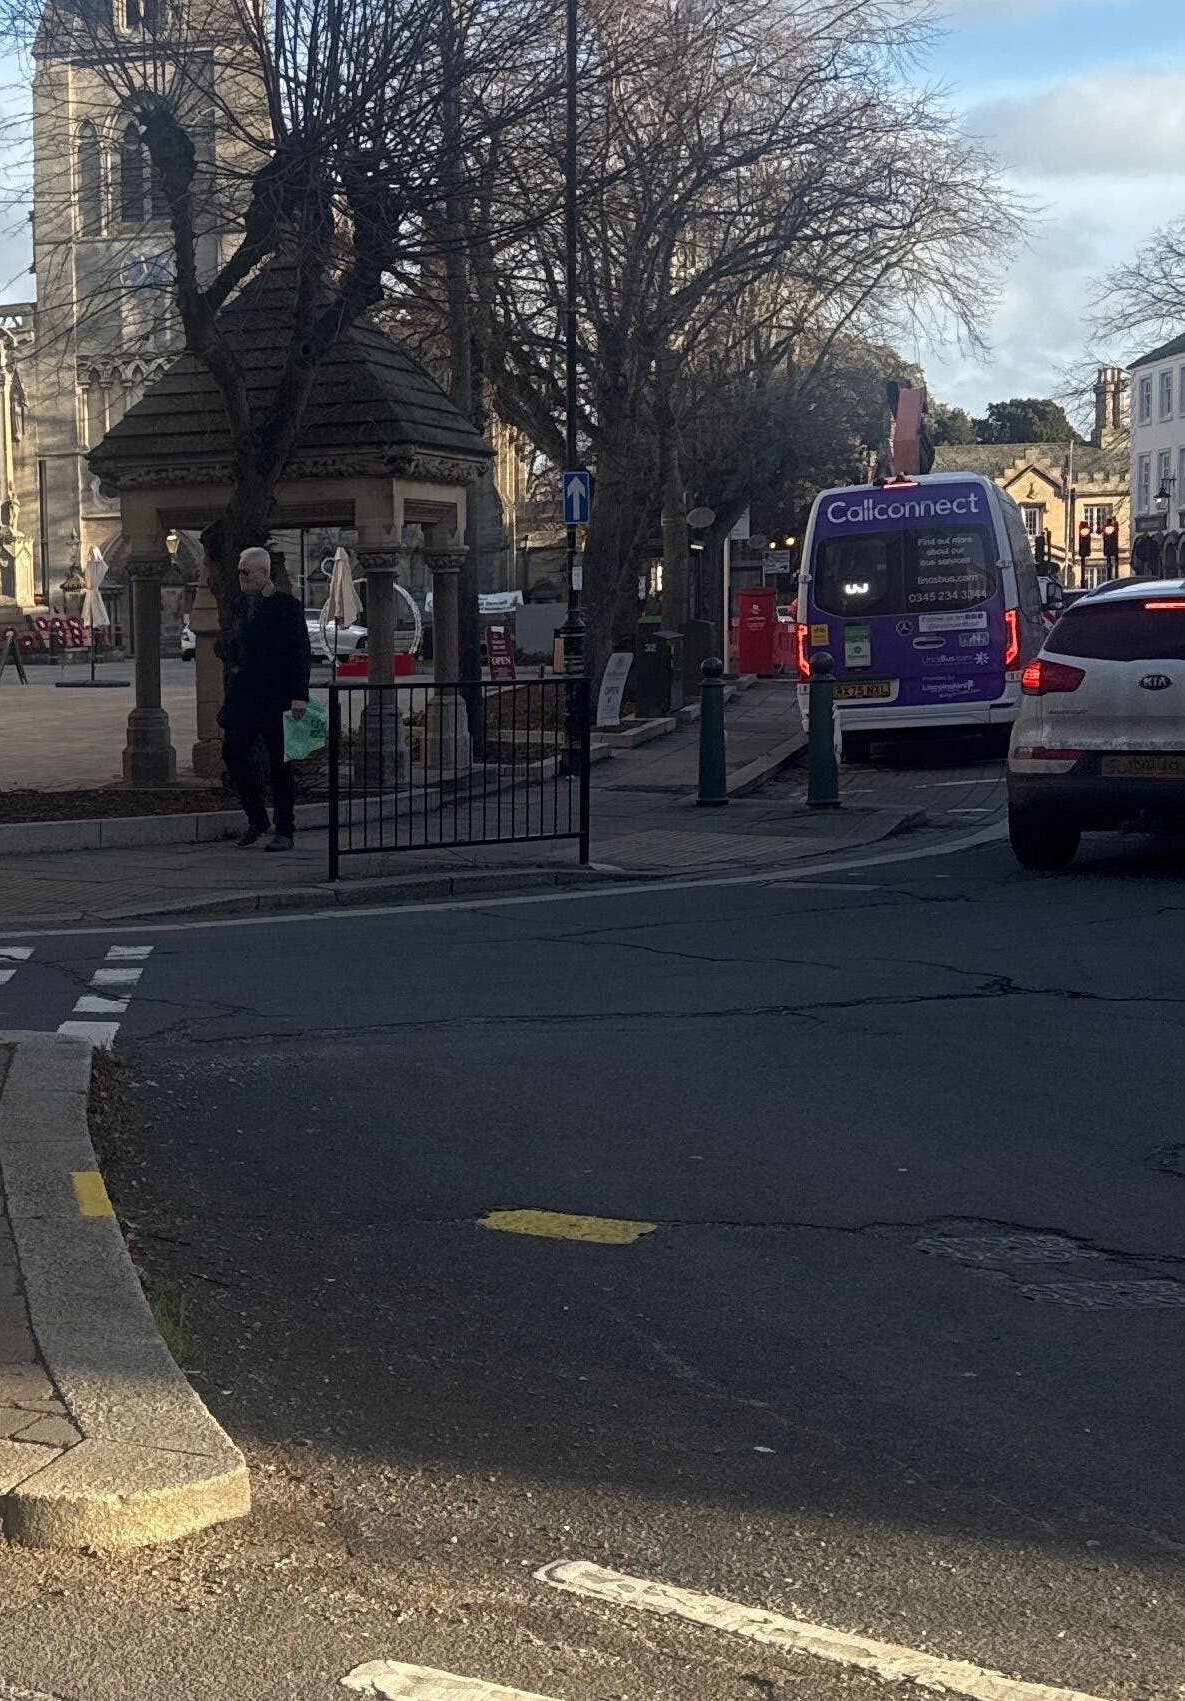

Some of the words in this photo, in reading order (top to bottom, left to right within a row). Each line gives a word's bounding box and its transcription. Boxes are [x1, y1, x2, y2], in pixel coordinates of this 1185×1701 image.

[827, 493, 979, 523] Callconnect
[917, 538, 935, 546] Find
[937, 537, 950, 545] out
[952, 536, 973, 544] more
[917, 574, 978, 585] lincsbus.com
[909, 592, 936, 603] 0345
[938, 590, 958, 601] 234
[644, 643, 657, 652] 32
[491, 656, 511, 665] OPEN
[1143, 677, 1167, 687] KIA
